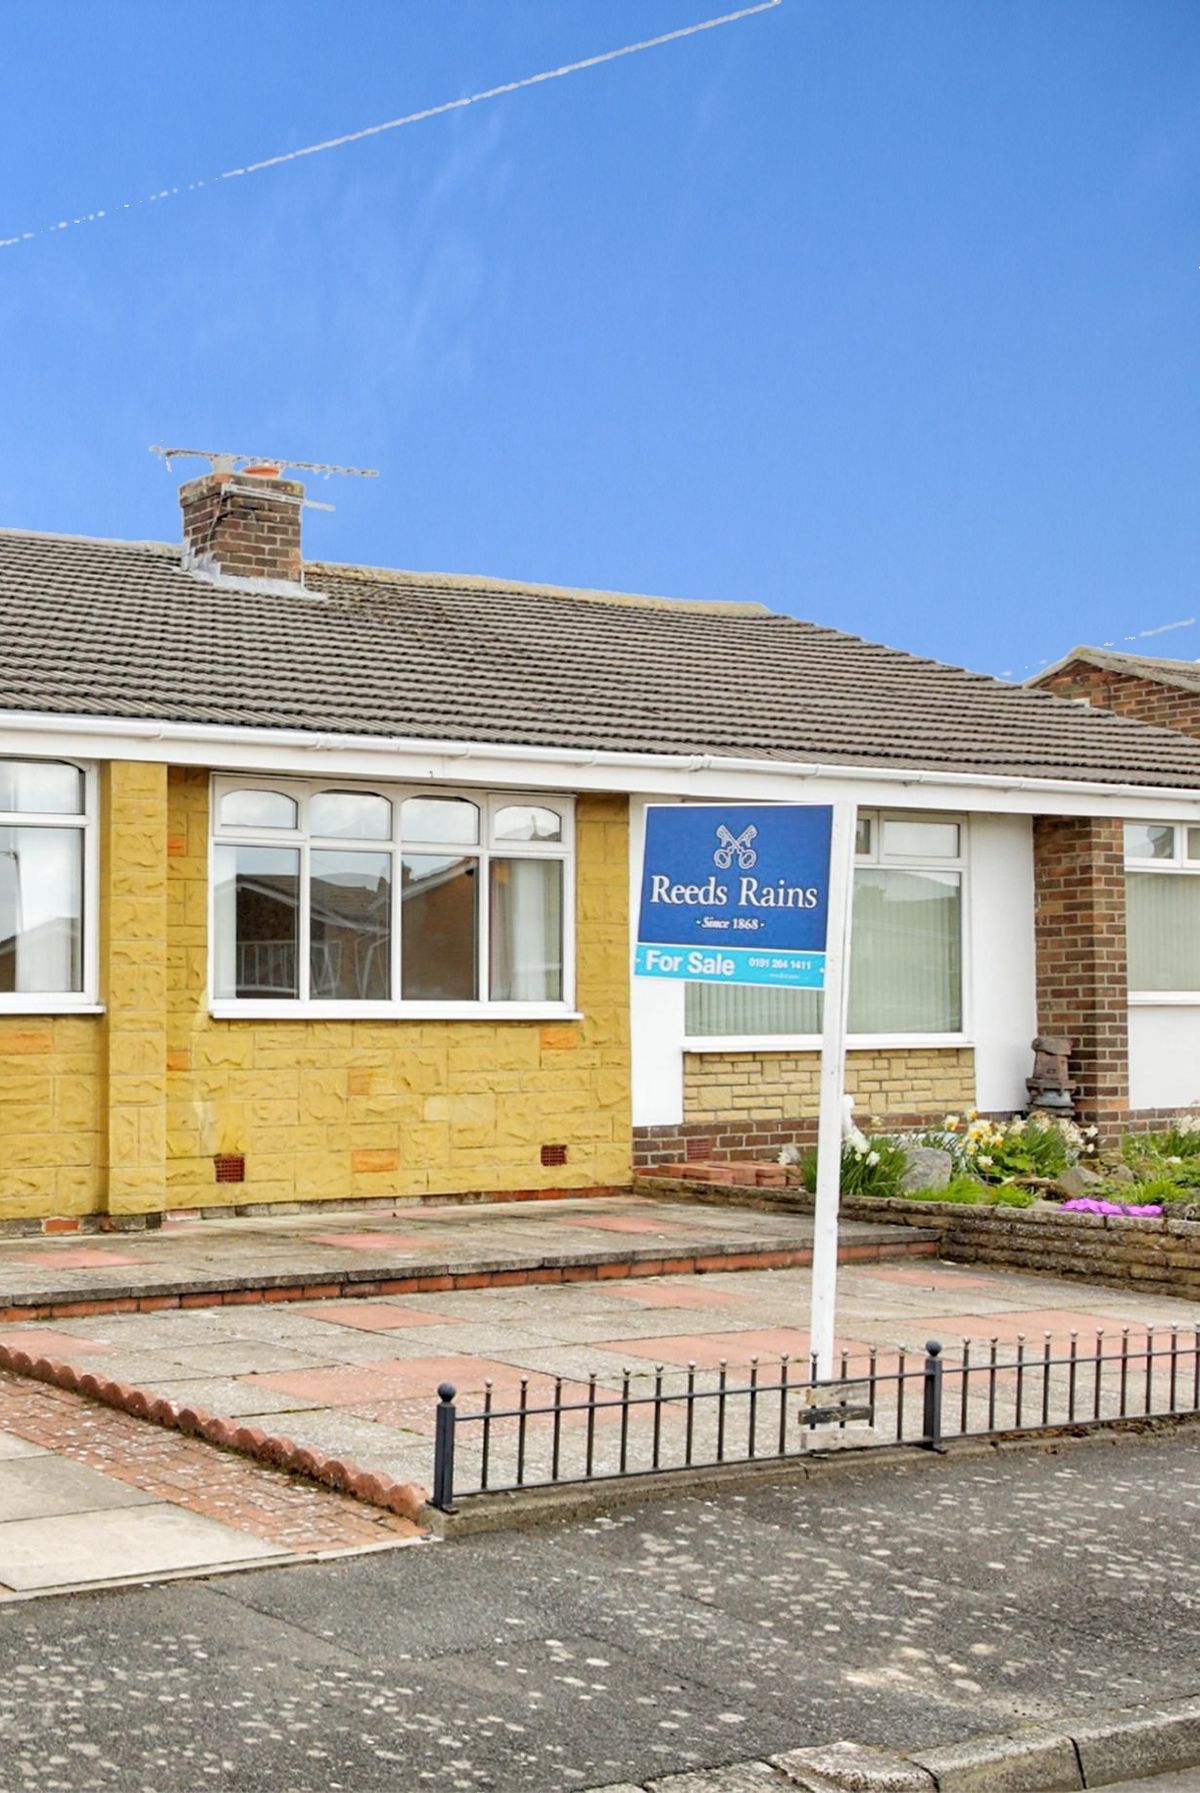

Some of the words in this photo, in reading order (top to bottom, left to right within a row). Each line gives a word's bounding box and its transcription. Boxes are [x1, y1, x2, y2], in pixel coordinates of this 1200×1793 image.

[650, 875, 728, 905] Reeds
[739, 877, 818, 908] Rains
[701, 917, 730, 929] Since
[733, 918, 759, 930] 1868
[646, 950, 683, 972] For
[687, 952, 735, 976] Sale
[748, 957, 769, 968] 0191
